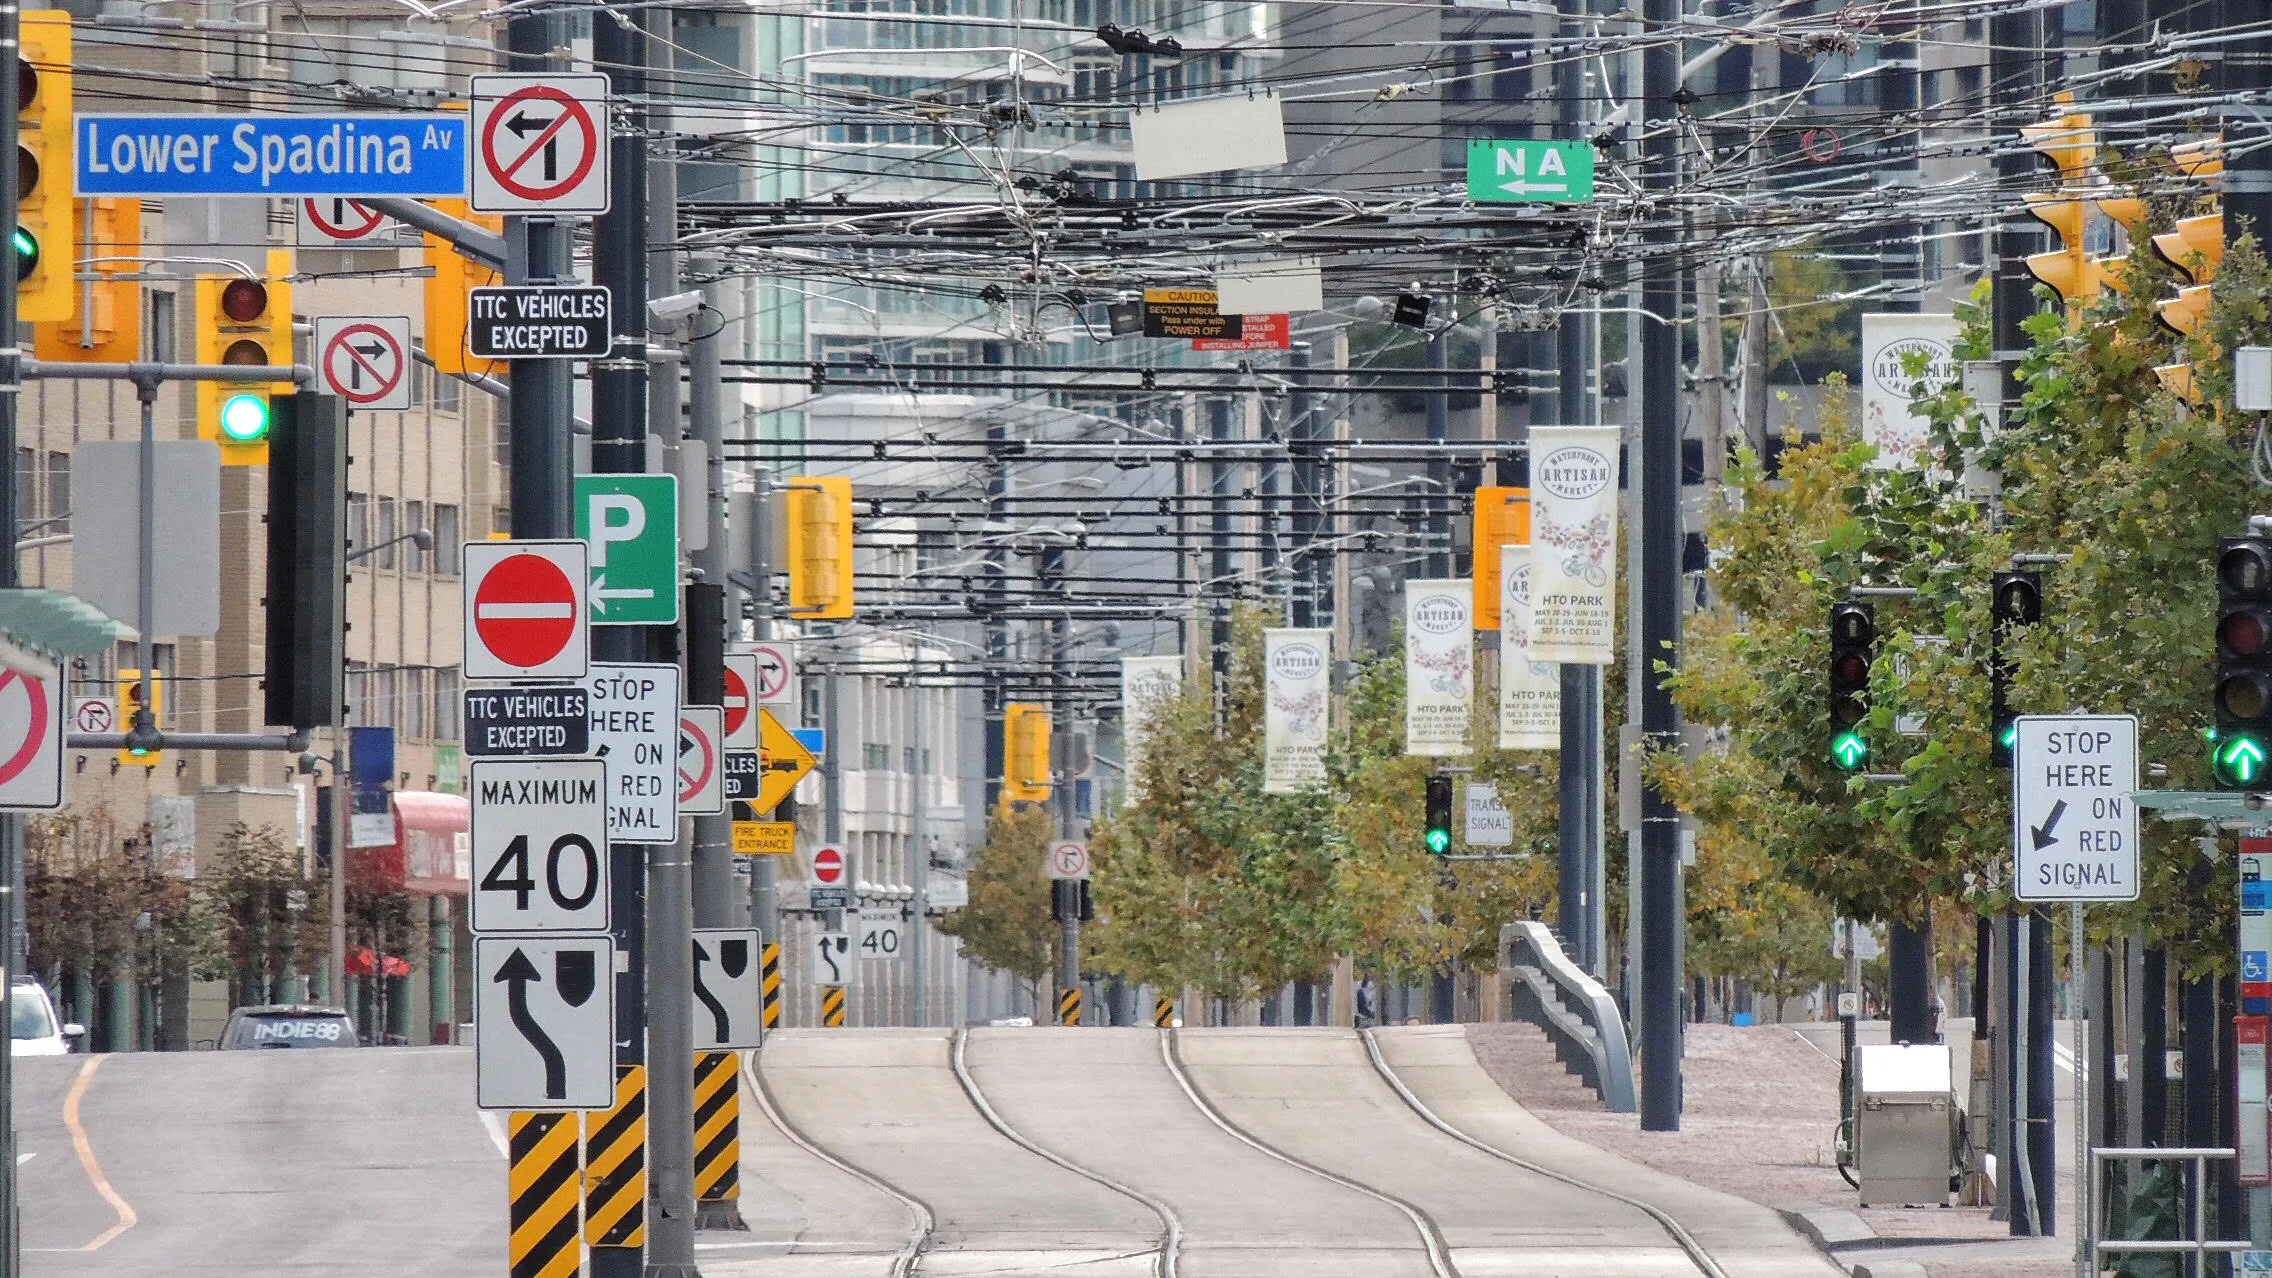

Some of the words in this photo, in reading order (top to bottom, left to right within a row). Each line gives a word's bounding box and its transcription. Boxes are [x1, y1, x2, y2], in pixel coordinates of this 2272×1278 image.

[88, 123, 219, 173] Lower
[233, 122, 410, 185] Spadina
[422, 126, 452, 152] Av
[1496, 148, 1525, 176] N
[1537, 148, 1567, 176] A
[474, 295, 510, 319] TTC
[516, 294, 605, 320] VEHICLES
[1149, 306, 1187, 314] SECTION
[1189, 307, 1218, 315] INSUL
[1161, 316, 1181, 324] Pass
[1183, 317, 1207, 325] under
[1209, 318, 1226, 326] with
[1164, 326, 1200, 335] POWER
[1202, 327, 1222, 335] OFF
[491, 326, 587, 349] EXCEPTED
[1544, 468, 1606, 481] ARTISAN
[588, 494, 646, 567] P
[1542, 595, 1567, 605] HTO
[1571, 596, 1604, 606] PARK
[593, 678, 655, 701] STOP
[1512, 691, 1536, 700] HTO
[1539, 691, 1560, 700] PAR
[468, 697, 498, 719] TTC
[504, 695, 585, 718] VEHICLES
[591, 711, 655, 733] HERE
[487, 726, 566, 748] EXCEPTED
[2047, 731, 2112, 754] STOP
[634, 743, 662, 765] ON
[622, 775, 662, 797] RED
[2047, 764, 2113, 787] HERE
[481, 780, 597, 805] MAXIMUM
[2092, 798, 2122, 820] ON
[735, 827, 756, 837] FIRE
[760, 828, 789, 837] TRUCK
[1471, 817, 1508, 830] SIGNAL
[738, 839, 788, 850] ENTRANCE
[2080, 830, 2122, 852] RED
[480, 832, 599, 911] 40
[2039, 863, 2122, 885] SIGNAL
[862, 929, 898, 954] 40
[253, 1021, 341, 1041] INDIE88
